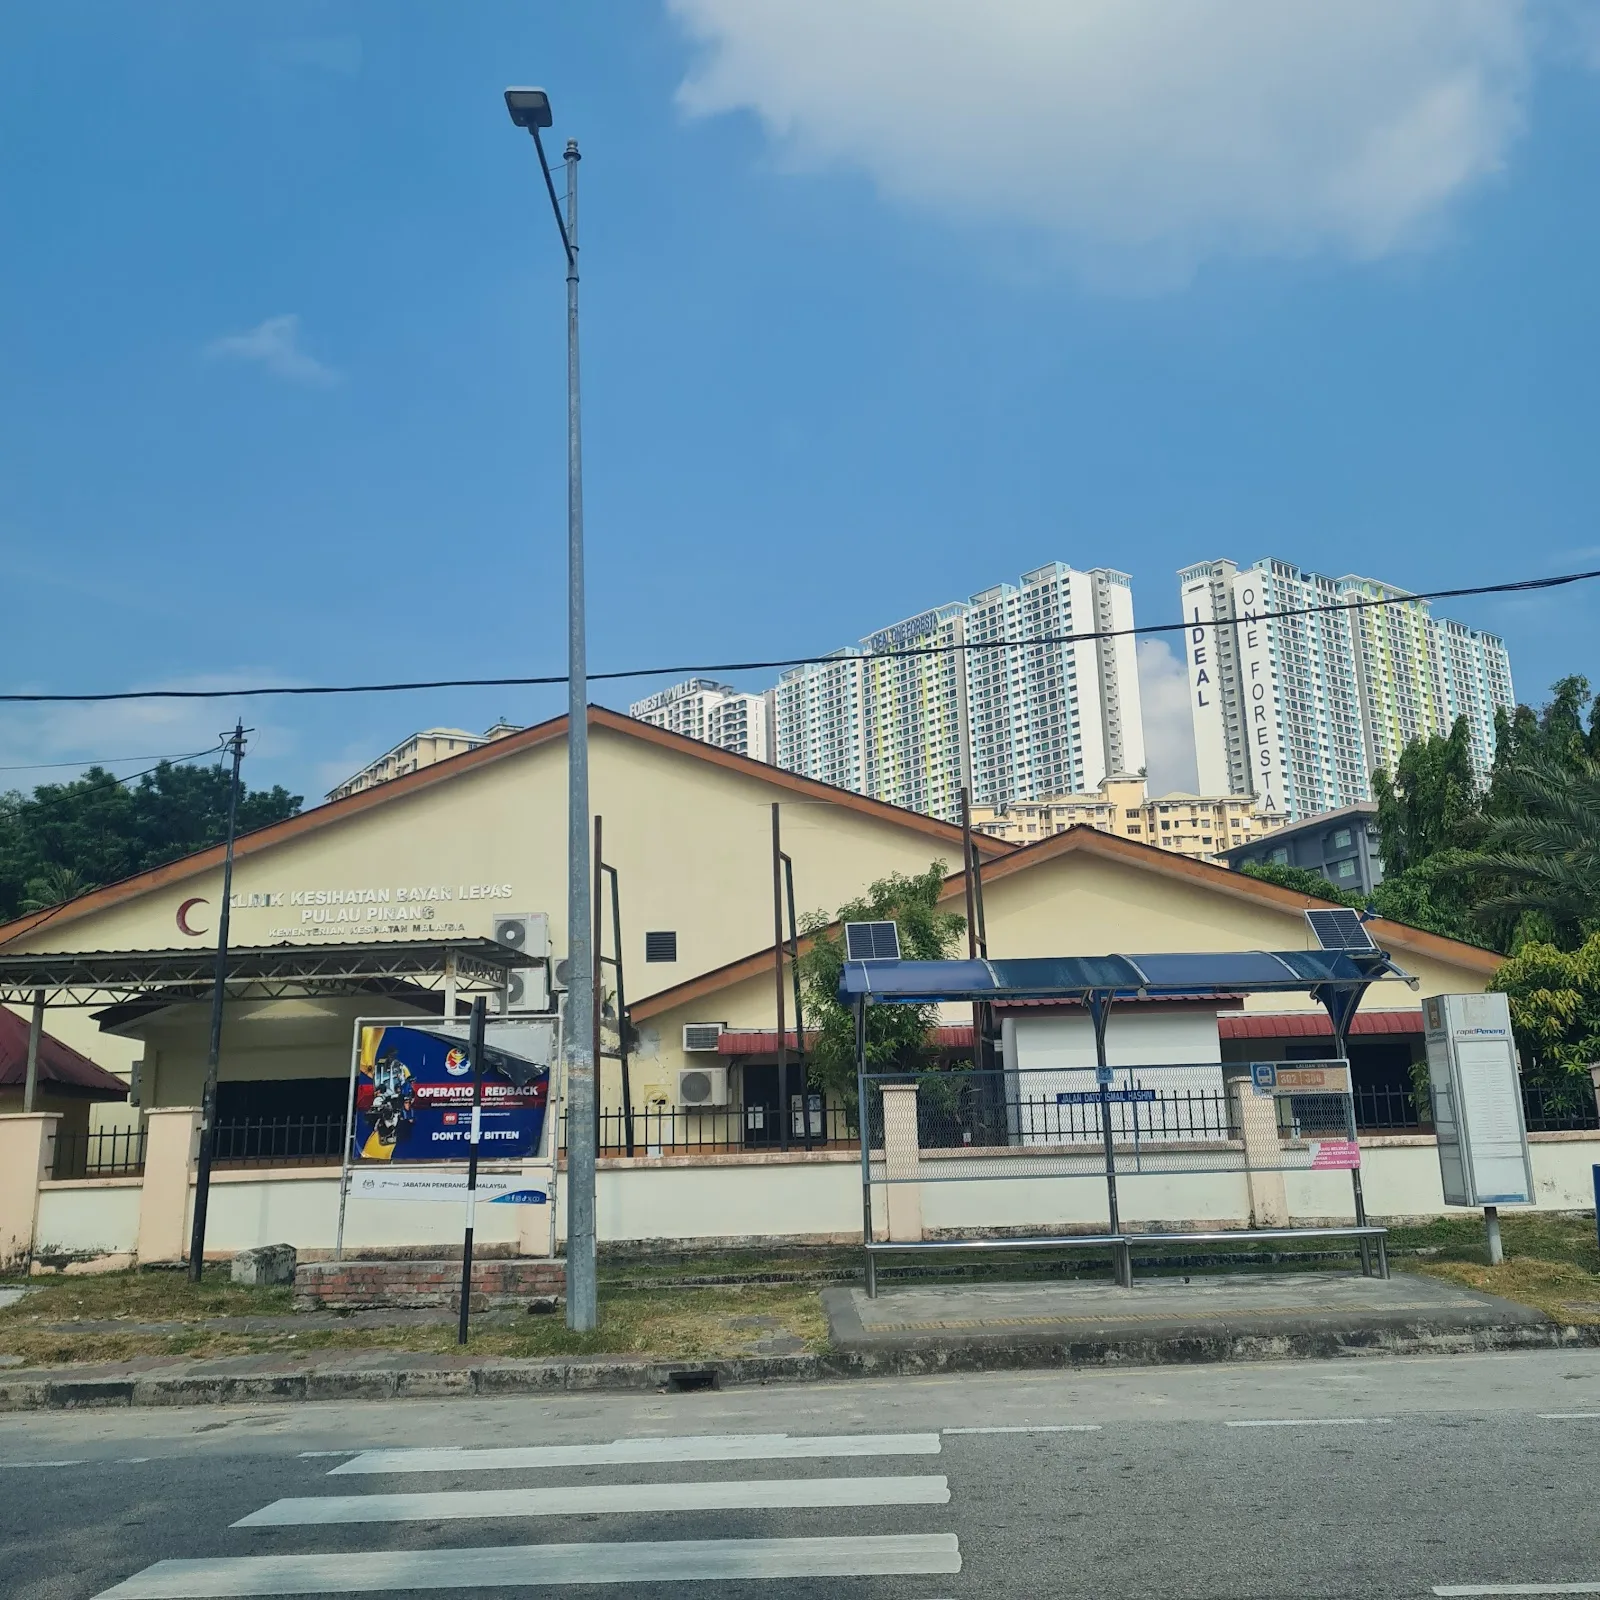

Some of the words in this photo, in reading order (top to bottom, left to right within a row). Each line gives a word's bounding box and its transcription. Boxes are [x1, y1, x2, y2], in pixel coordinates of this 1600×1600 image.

[906, 611, 939, 639] FORESTA
[1192, 606, 1210, 708] IDEAL
[629, 691, 663, 717] FOREST
[670, 677, 697, 701] VILLE
[1242, 588, 1259, 649] ONE
[1251, 661, 1276, 811] FORESTA
[229, 892, 284, 909] KLINIK
[290, 887, 390, 907] KESIHATAN
[396, 885, 453, 903] BAYAN
[459, 883, 513, 901] LEPAS
[301, 907, 360, 924] PULAU
[367, 905, 435, 921] PINANG
[268, 925, 345, 938] KEMENTERIAN
[349, 923, 408, 936] KESIHATAN
[412, 922, 465, 934] MALAYSIA
[1456, 1028, 1506, 1036] rapidPenang
[1280, 1074, 1297, 1084] 302
[417, 1086, 480, 1098] OPERATIO
[484, 1085, 539, 1097] REDBACK
[1061, 1093, 1083, 1103] JALAN
[1104, 1091, 1126, 1101] ISMAIL
[1127, 1090, 1153, 1101] HASHIM
[431, 1131, 462, 1142] DON'T
[464, 1131, 482, 1141] GT
[484, 1131, 520, 1141] BITTEN
[432, 1182, 469, 1190] PENERANGA
[476, 1182, 507, 1190] MALAYSIA
